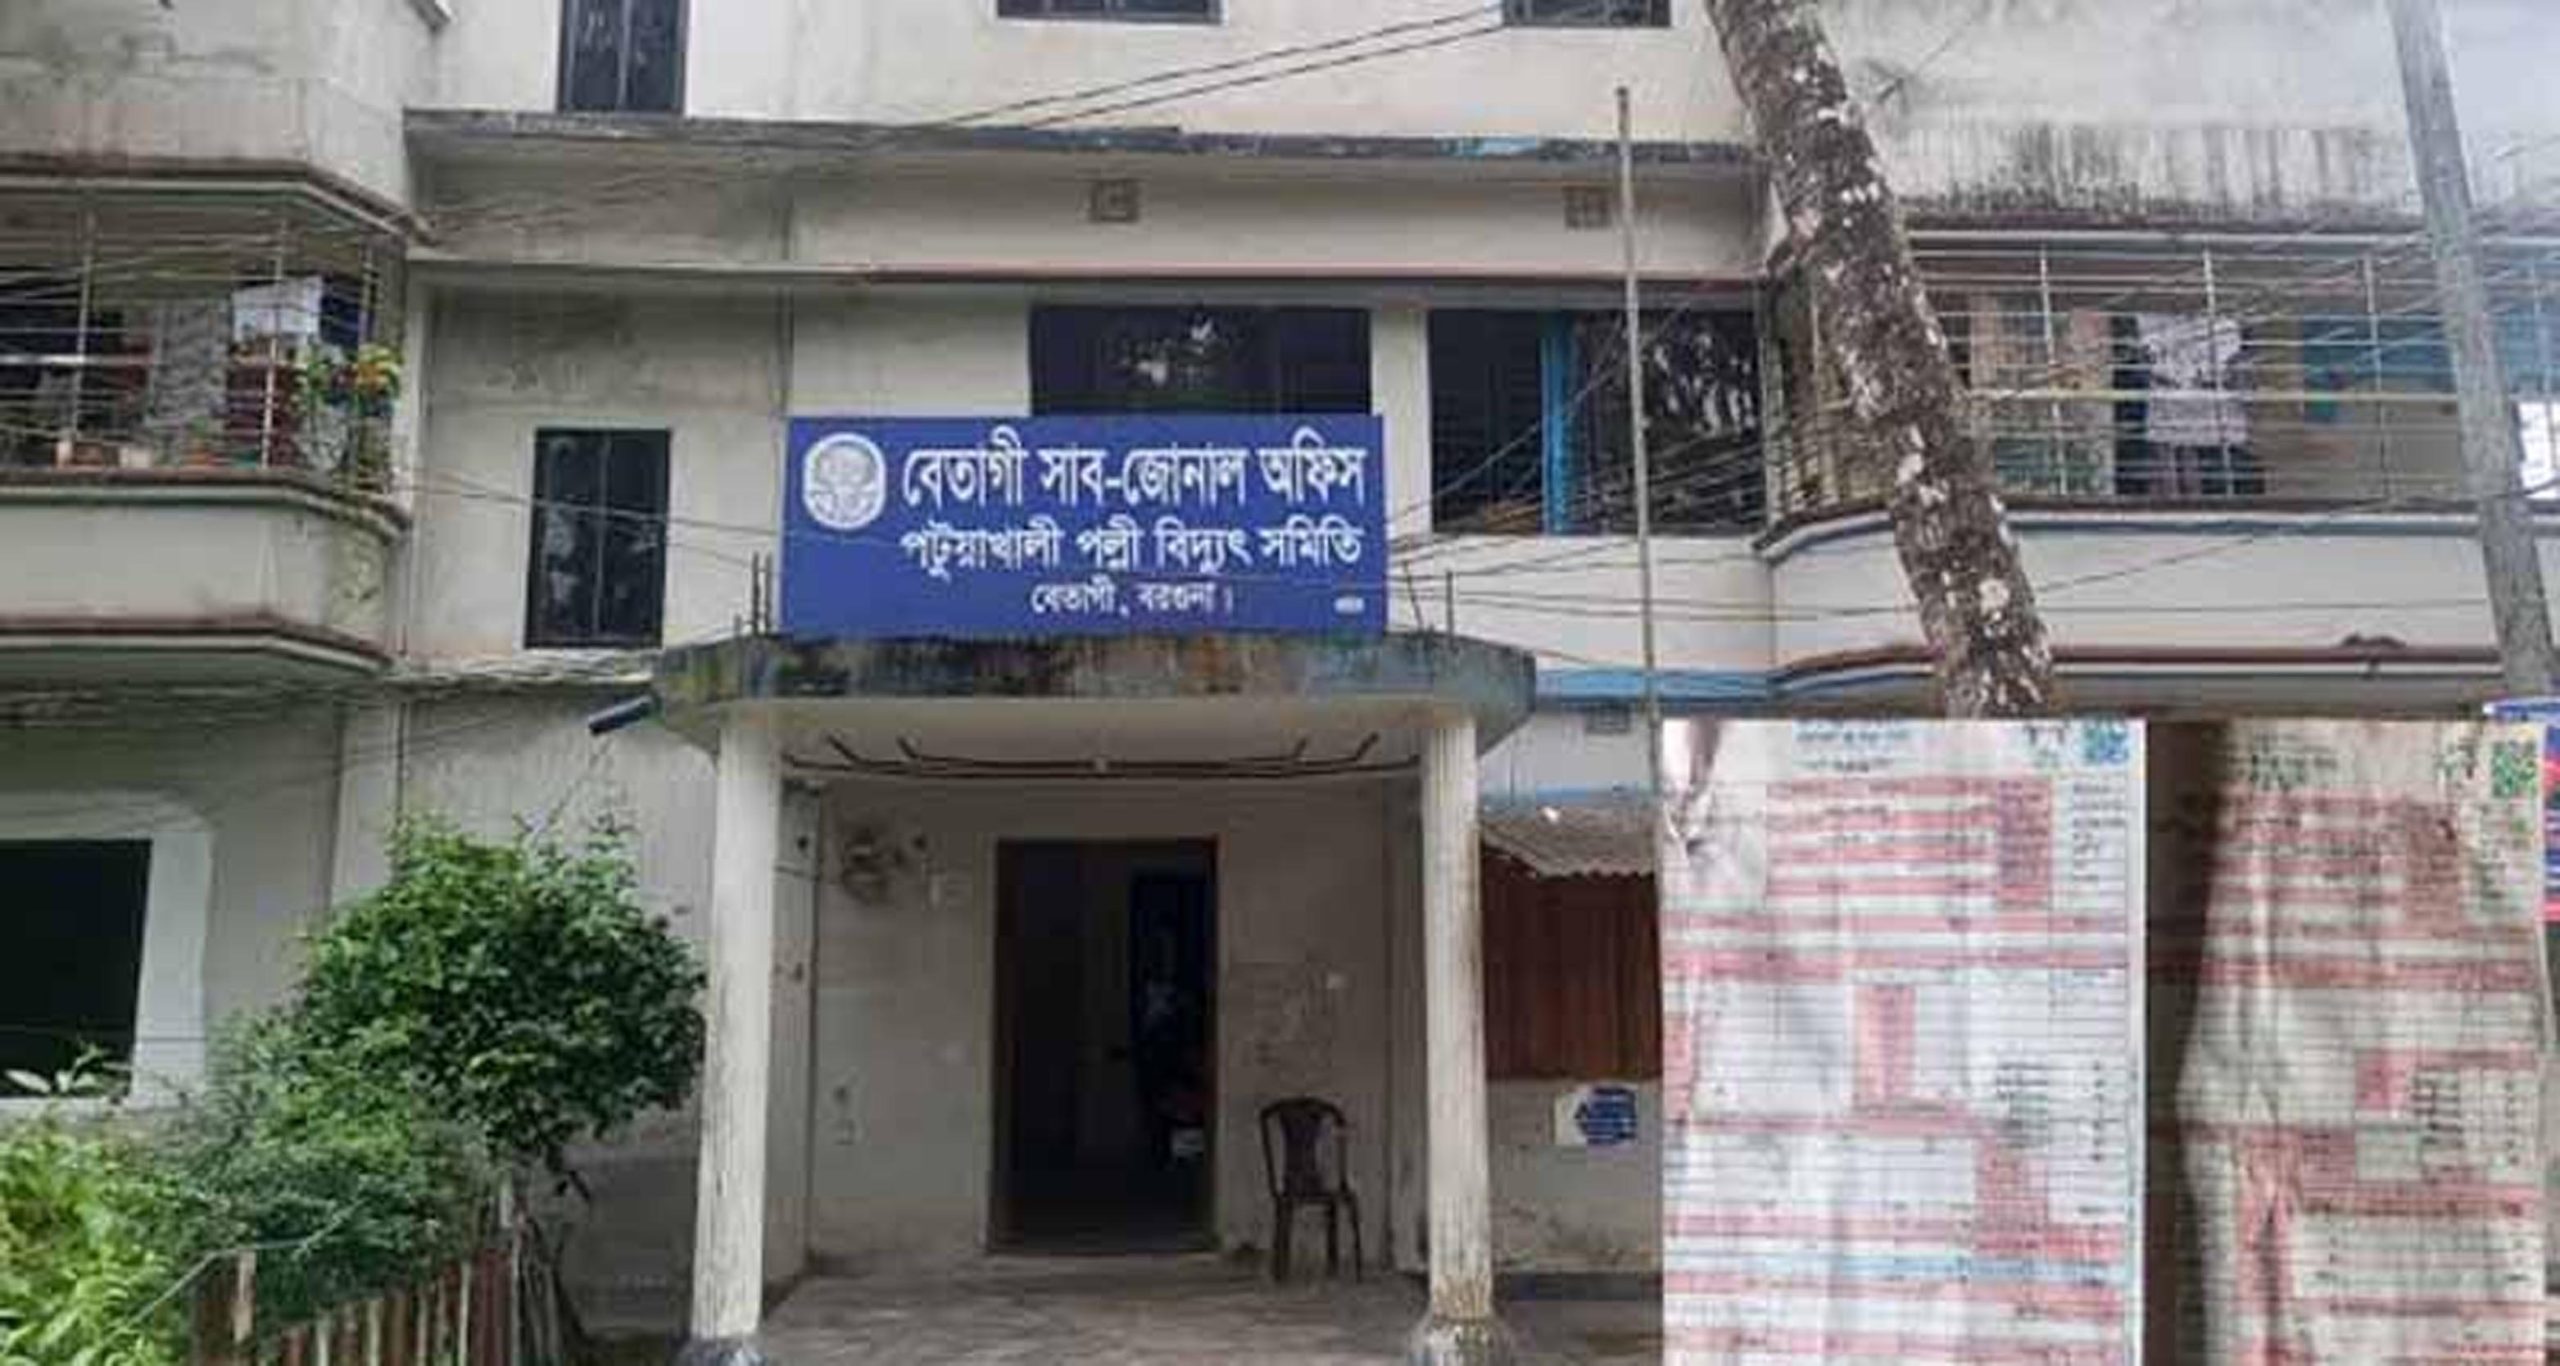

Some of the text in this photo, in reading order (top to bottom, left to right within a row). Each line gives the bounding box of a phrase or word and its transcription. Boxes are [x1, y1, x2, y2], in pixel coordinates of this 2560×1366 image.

[903, 425, 1368, 509] বেতাগী সাব-জোনাল অফিস
[900, 513, 1365, 582] পটুয়াখালী পল্লী বিদ্যুৎ সমিতি
